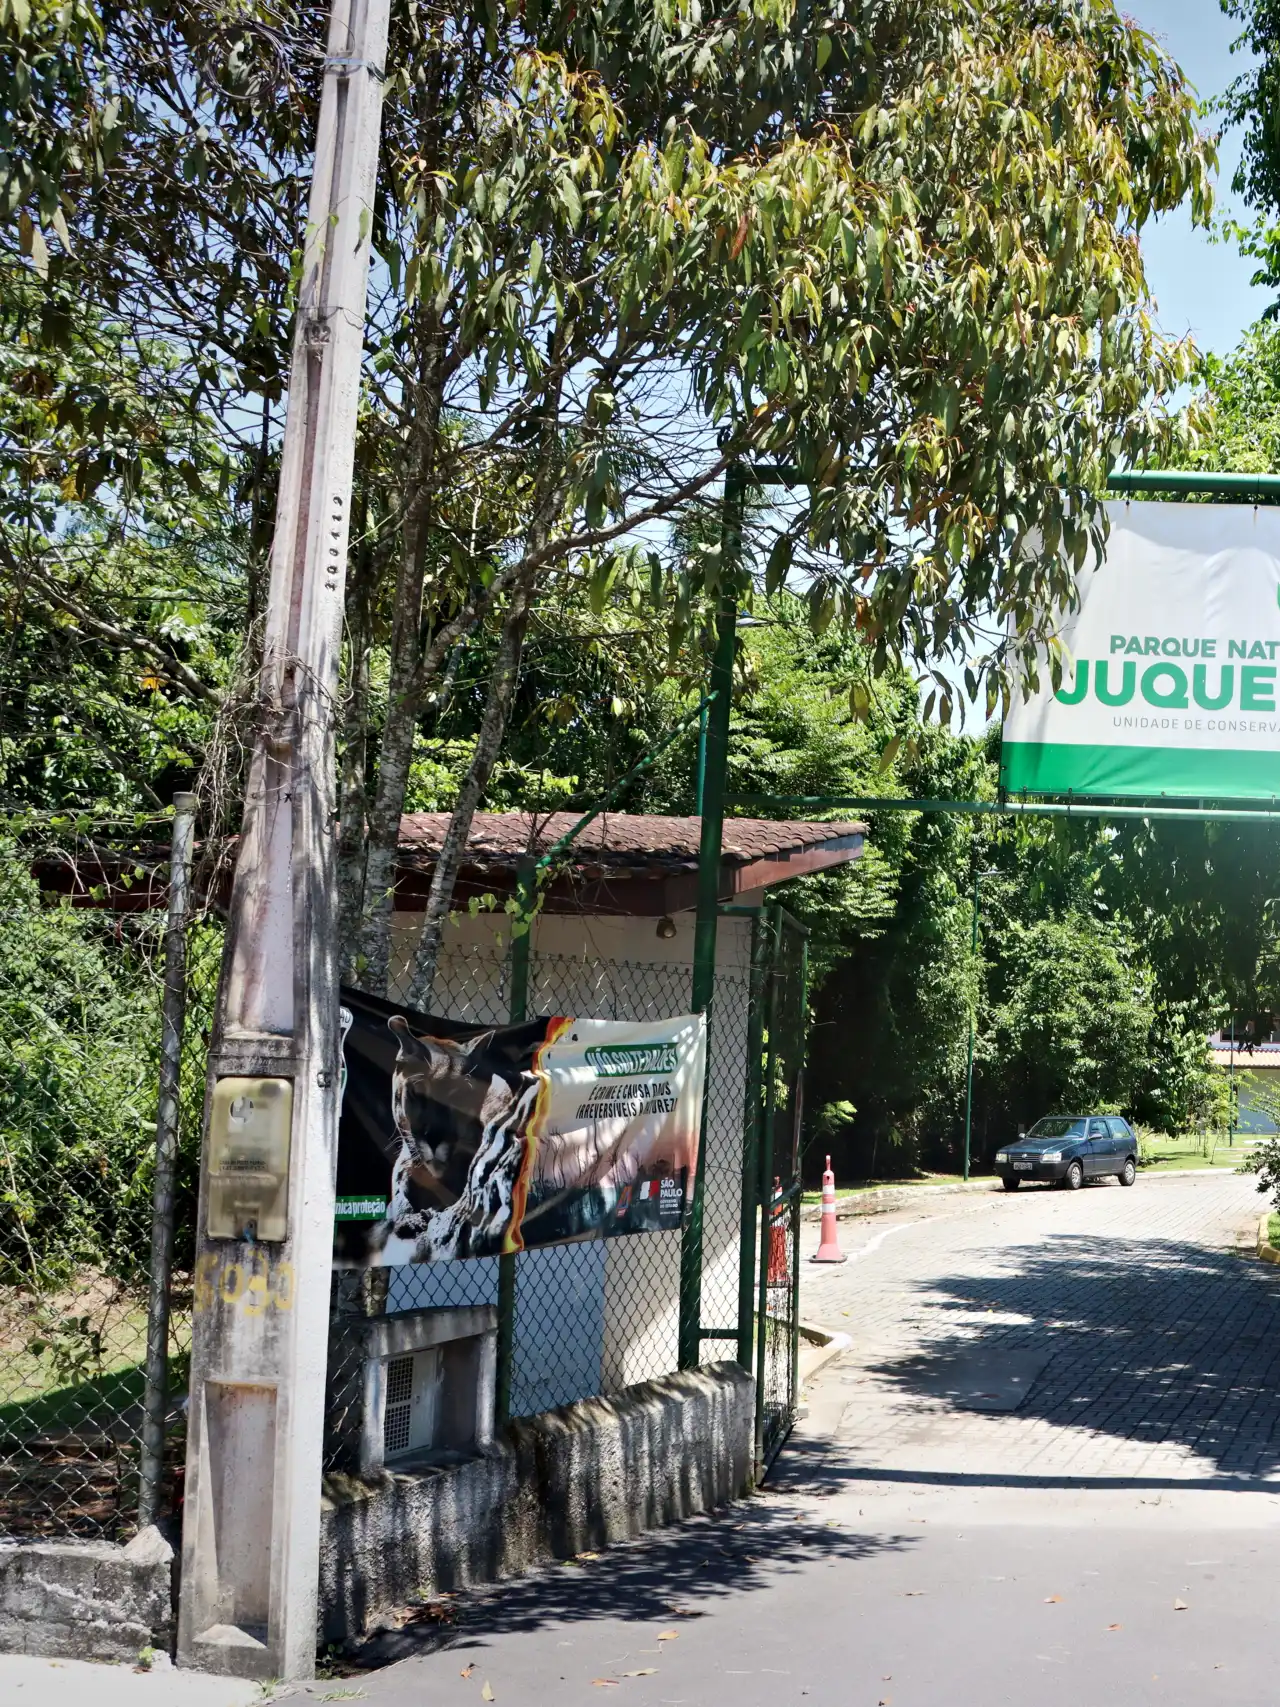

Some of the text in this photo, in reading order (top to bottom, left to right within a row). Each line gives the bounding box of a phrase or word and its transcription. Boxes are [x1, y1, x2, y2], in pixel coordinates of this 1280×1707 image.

[1110, 635, 1216, 658] PARQUE
[1113, 716, 1179, 730] UNIDADE
[1184, 719, 1202, 731] DE
[594, 1084, 618, 1101] CRIME
[623, 1083, 651, 1099] CAUSA
[575, 1100, 637, 1119] IRREVERSÍVEIS
[660, 1177, 674, 1189] SÃO
[660, 1188, 683, 1198] PAULO
[335, 1198, 386, 1218] nica proteção
